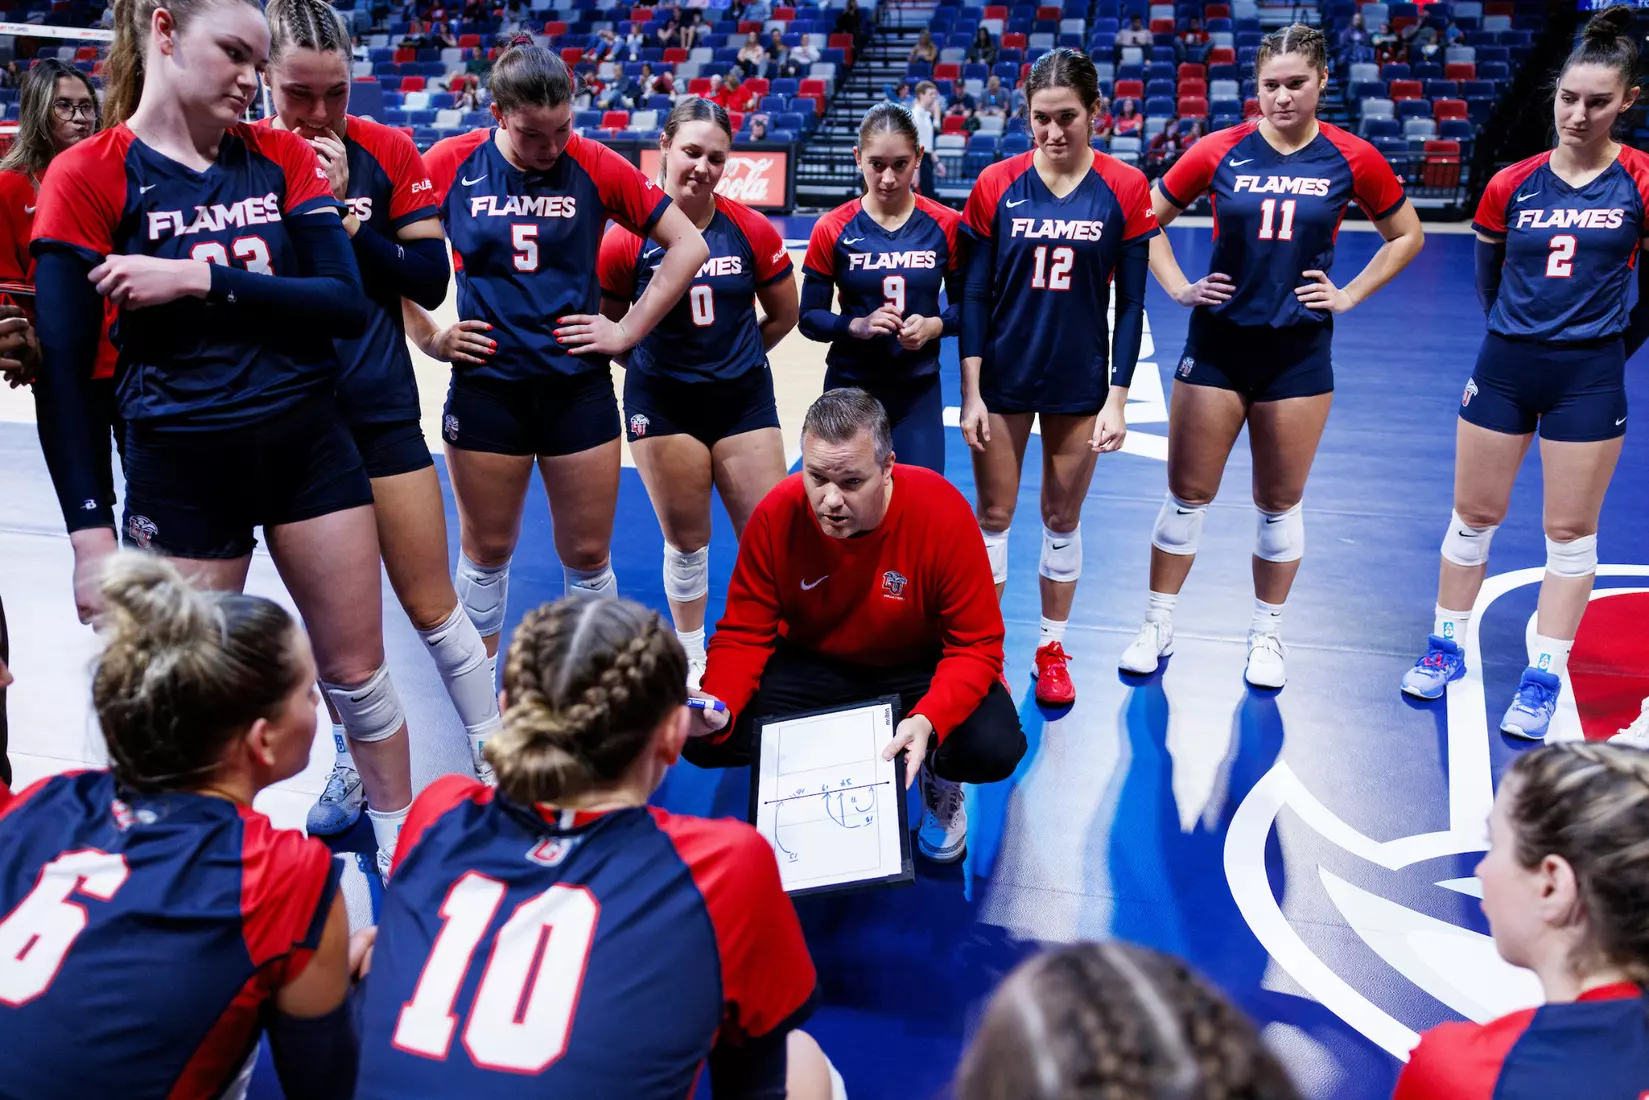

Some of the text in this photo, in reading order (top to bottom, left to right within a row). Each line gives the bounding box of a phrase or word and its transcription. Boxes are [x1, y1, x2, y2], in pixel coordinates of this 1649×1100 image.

[470, 195, 577, 218] FLAMES
[1233, 174, 1331, 197] FLAMES
[147, 192, 282, 240] FLAMES
[1011, 218, 1104, 242] FLAMES
[1258, 198, 1296, 241] 11
[1516, 208, 1625, 229] FLAMES
[511, 223, 539, 273] 5
[848, 250, 937, 271] FLAMES
[1031, 245, 1076, 291] 12
[1545, 233, 1578, 279] 2
[690, 283, 715, 327] 0
[882, 274, 906, 315] 9
[0, 848, 131, 1008] 6
[391, 868, 602, 1077] 10
